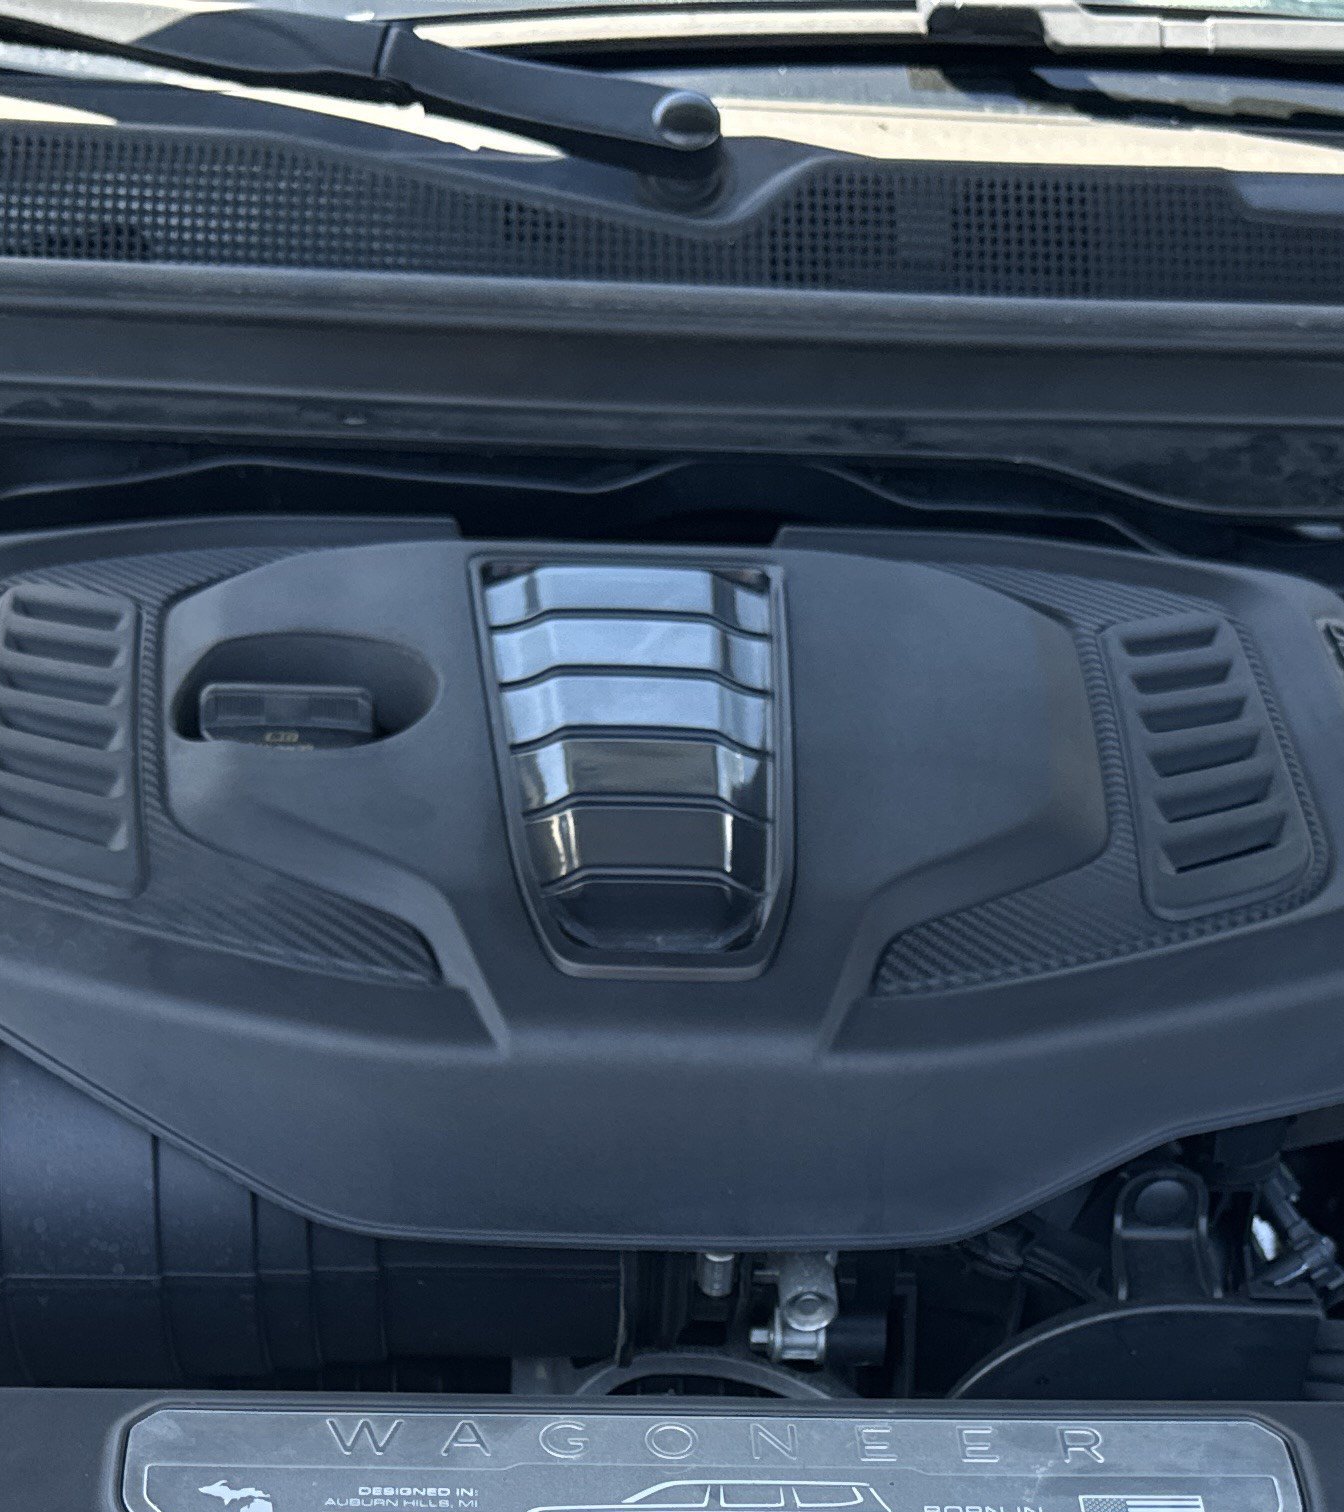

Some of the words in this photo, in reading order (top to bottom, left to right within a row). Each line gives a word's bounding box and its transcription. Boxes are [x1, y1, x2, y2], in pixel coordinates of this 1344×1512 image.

[326, 1417, 1105, 1464] WAGONEER
[358, 1486, 451, 1497] DESIGNED
[455, 1487, 479, 1497] IN:
[324, 1497, 399, 1508] AUBURN
[403, 1499, 454, 1509] HILLS,
[458, 1499, 479, 1508] MI
